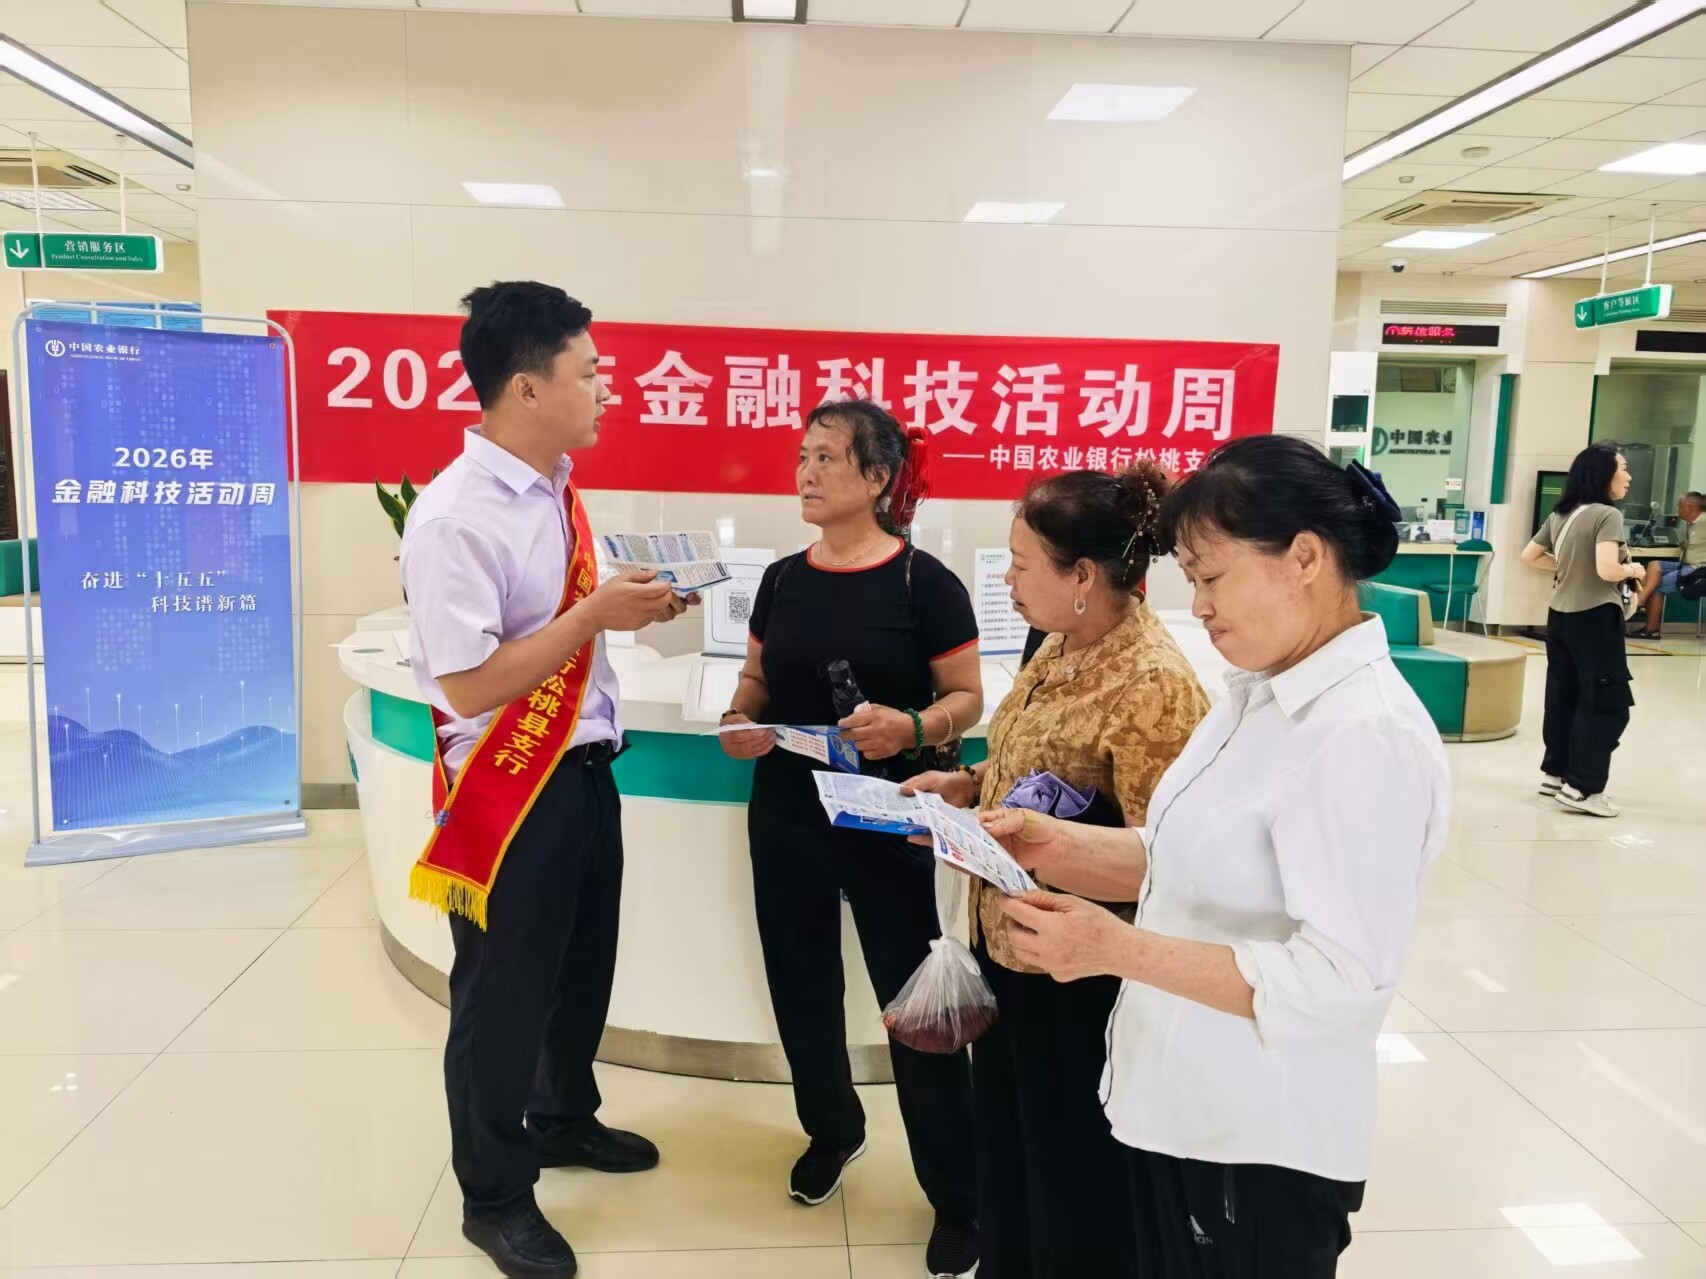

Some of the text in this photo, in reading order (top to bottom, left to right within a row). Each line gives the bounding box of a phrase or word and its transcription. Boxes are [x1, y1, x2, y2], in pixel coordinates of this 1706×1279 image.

[64, 240, 126, 253] 营销服务区
[69, 341, 141, 356] 中国农业银行
[326, 346, 1237, 442] 202金融科技活动周
[114, 446, 214, 471] 2026年
[51, 478, 276, 507] 金融科技活动周
[151, 594, 257, 613] 科技谱新篇
